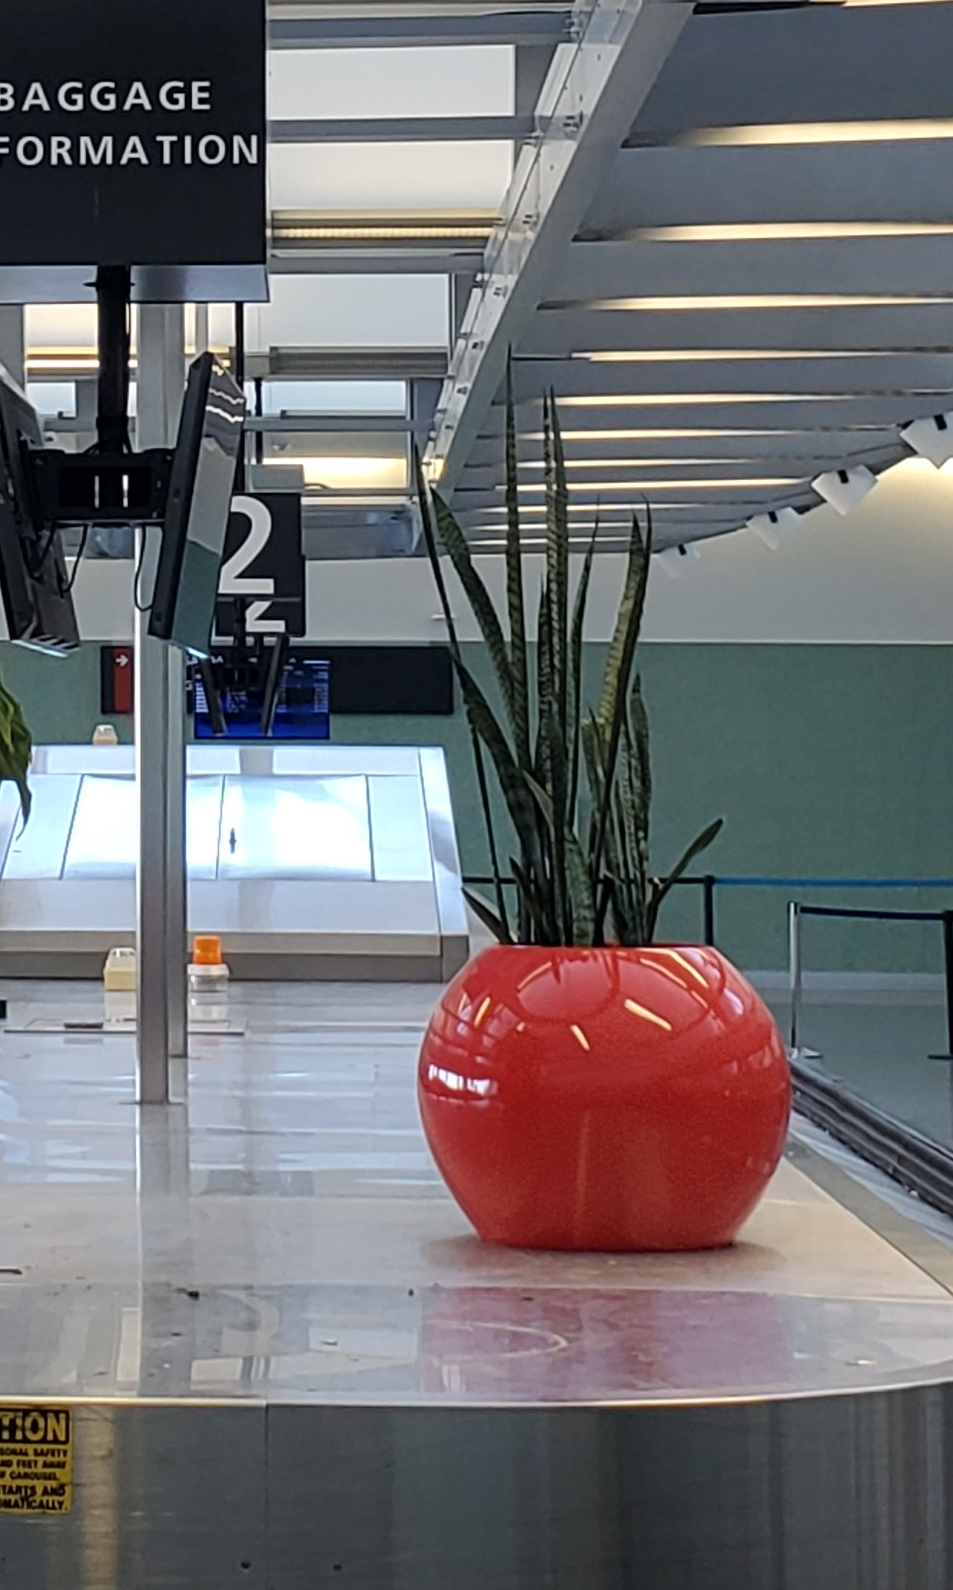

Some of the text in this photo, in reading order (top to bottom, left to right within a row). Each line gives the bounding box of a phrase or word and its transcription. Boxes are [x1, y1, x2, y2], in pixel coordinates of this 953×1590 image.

[217, 495, 275, 594] 2
[33, 1448, 68, 1458] SAFETY
[16, 1459, 38, 1469] FEET
[41, 1460, 67, 1470] AWAY
[41, 1484, 67, 1497] AND
